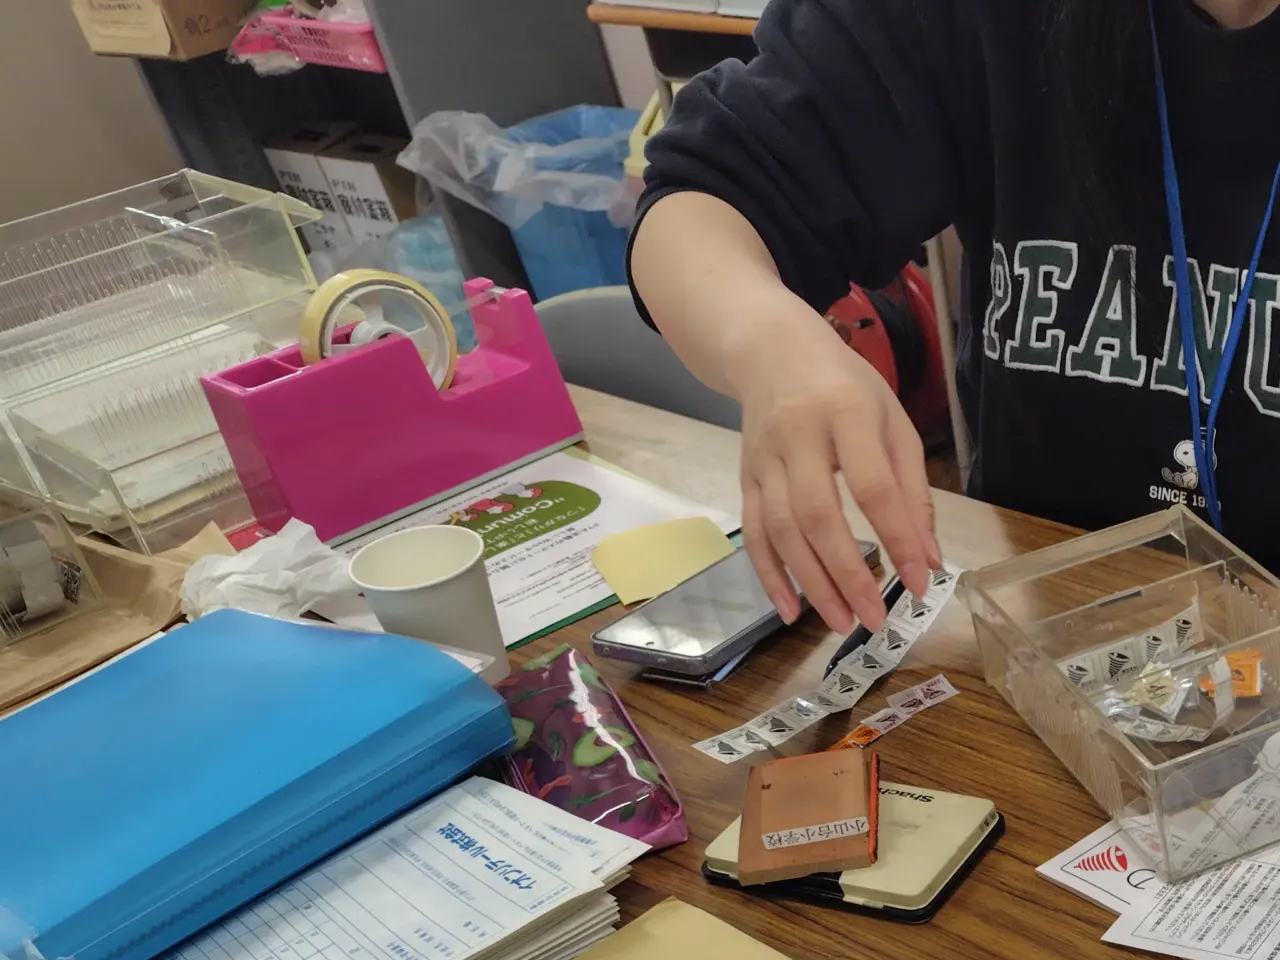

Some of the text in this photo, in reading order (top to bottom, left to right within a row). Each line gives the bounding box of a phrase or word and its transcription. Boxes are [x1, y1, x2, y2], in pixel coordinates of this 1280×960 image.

[1149, 485, 1188, 504] SINCE
[765, 819, 867, 847] 小山台小学校
[436, 820, 537, 893] イオンリテール株式会社
